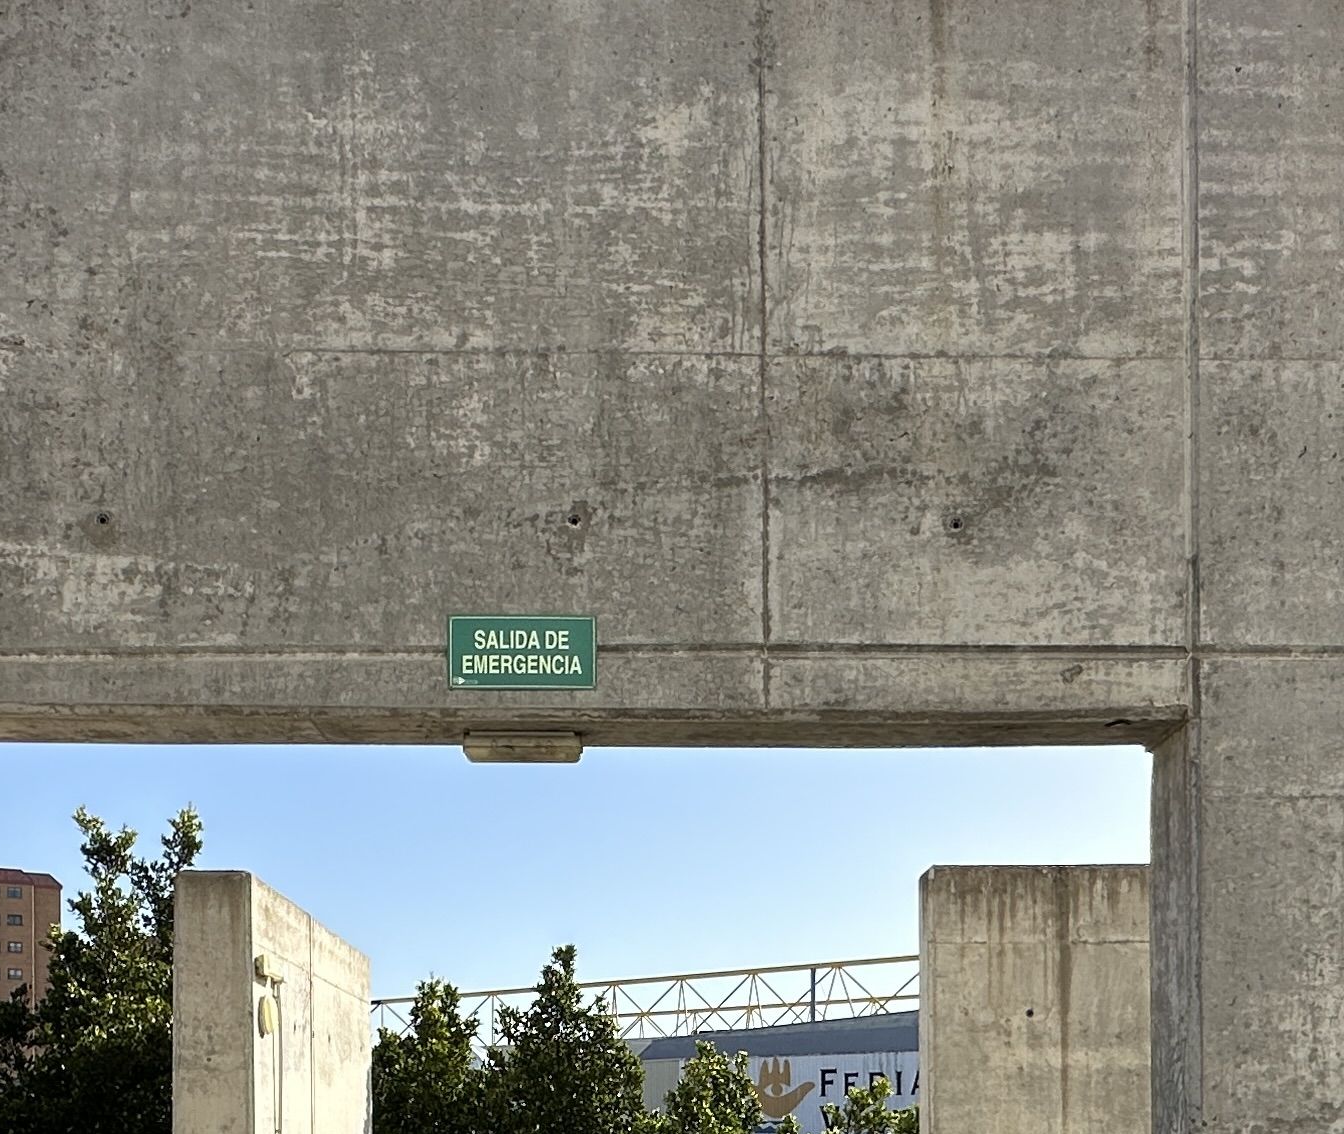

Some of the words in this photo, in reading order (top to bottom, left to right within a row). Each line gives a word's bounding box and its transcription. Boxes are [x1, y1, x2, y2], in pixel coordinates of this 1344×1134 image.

[474, 630, 540, 650] SALIDA
[545, 630, 569, 650] DE
[462, 654, 582, 675] EMERGENCIA
